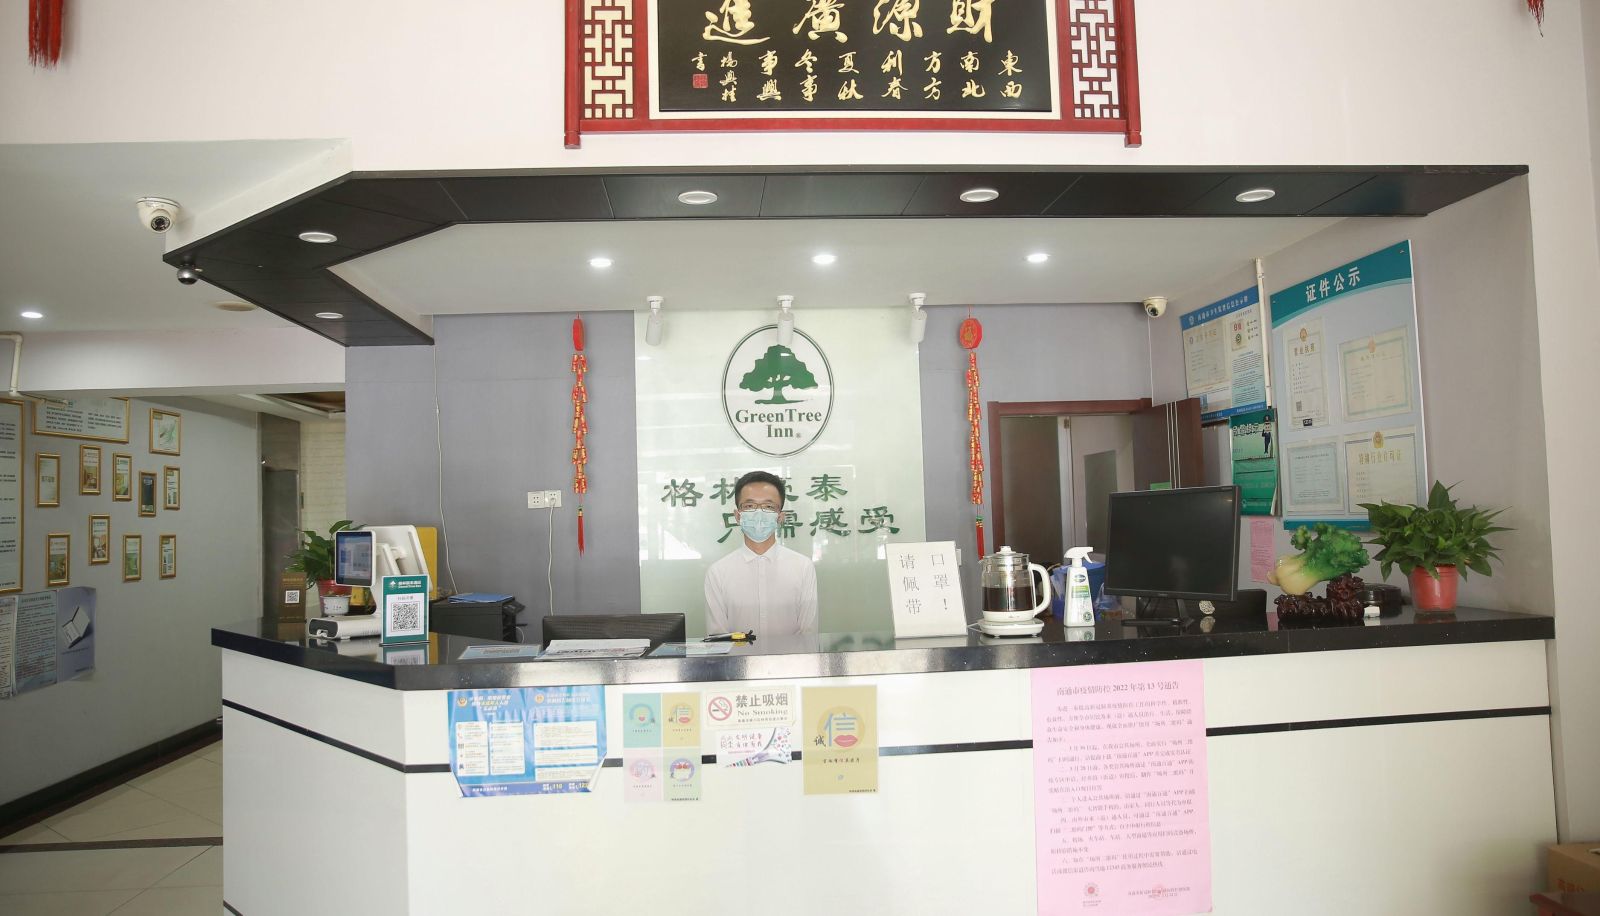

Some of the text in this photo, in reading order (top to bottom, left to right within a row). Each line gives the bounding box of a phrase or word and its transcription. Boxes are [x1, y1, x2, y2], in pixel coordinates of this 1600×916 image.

[1305, 266, 1361, 304] 证件公示
[735, 408, 822, 423] GreenTree
[767, 424, 794, 438] Inn
[1112, 683, 1129, 692] 2022
[1147, 681, 1155, 691] 13
[735, 692, 788, 708] 禁止吸烟
[752, 708, 789, 716] Smoking
